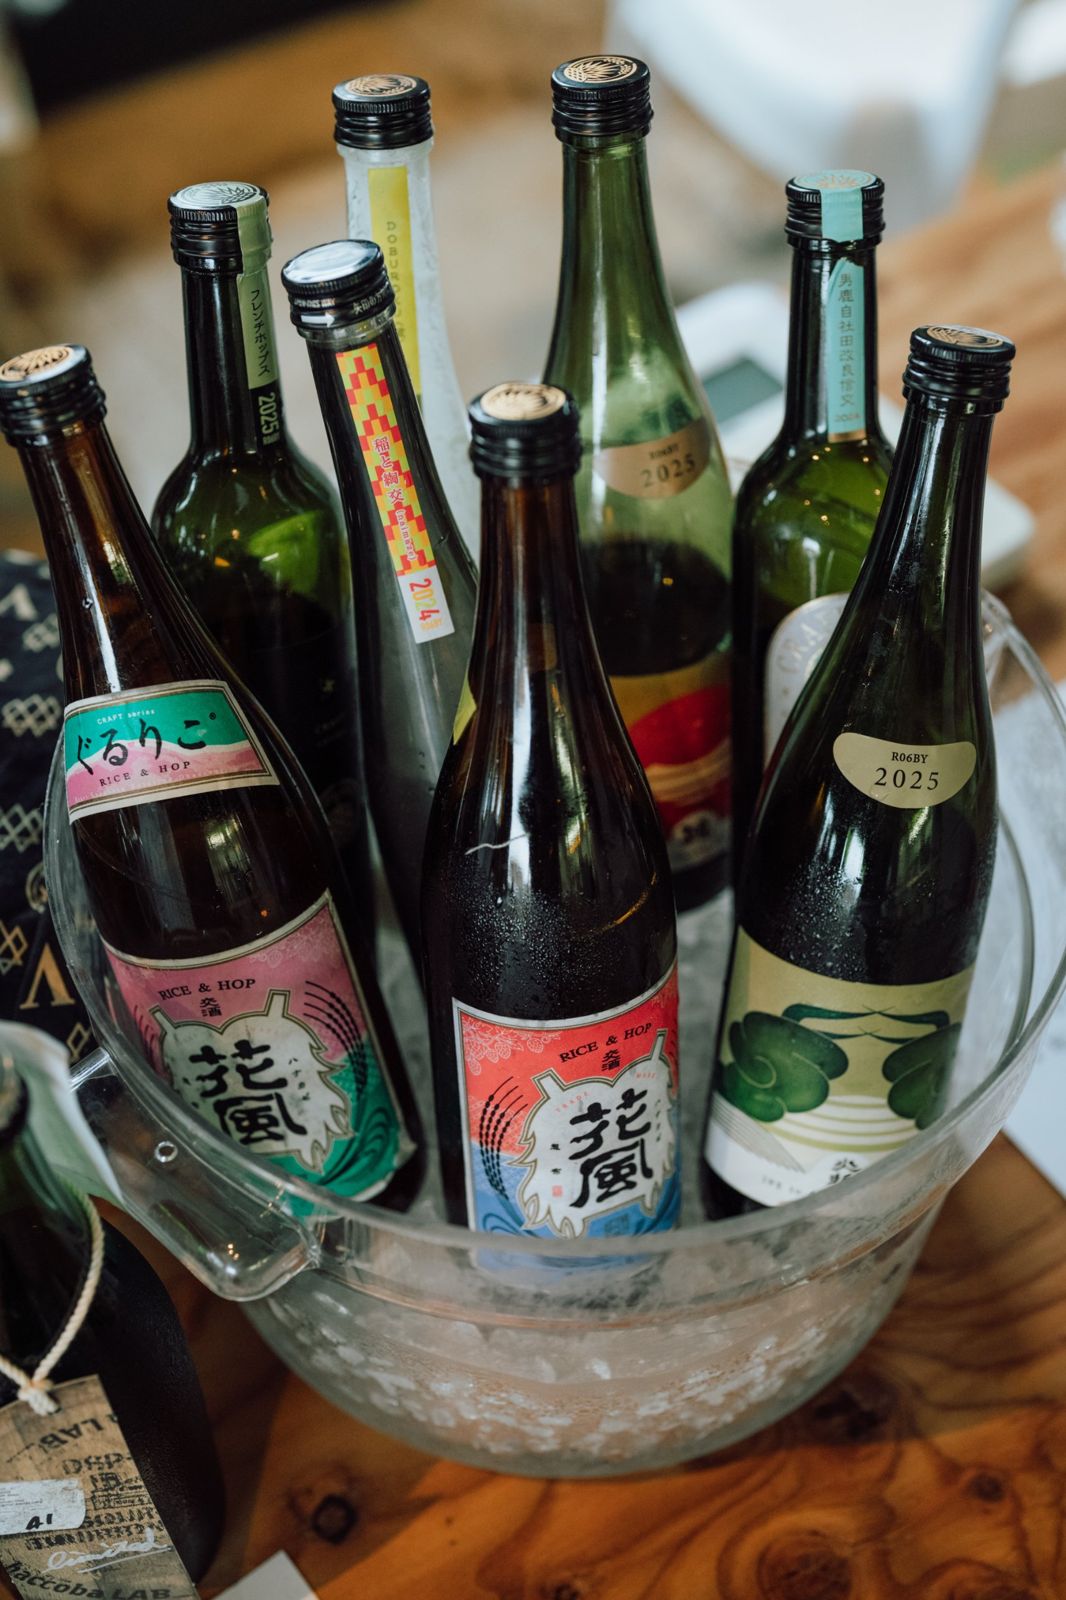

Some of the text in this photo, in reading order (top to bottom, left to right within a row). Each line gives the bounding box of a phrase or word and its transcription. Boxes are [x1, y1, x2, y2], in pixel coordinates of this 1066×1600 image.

[250, 288, 271, 378] フレンチホップス
[258, 391, 280, 434] 2025
[640, 453, 695, 489] 2025
[408, 577, 440, 622] 2024
[96, 712, 123, 726] CRAFT
[99, 760, 191, 787] RICE & HOP
[891, 751, 929, 764] R06BY
[874, 767, 940, 791] 2025
[158, 978, 256, 1001] RICE & HOP
[559, 1022, 653, 1063] RICE & HOP
[6, 1562, 172, 1600] haccoba LAB
